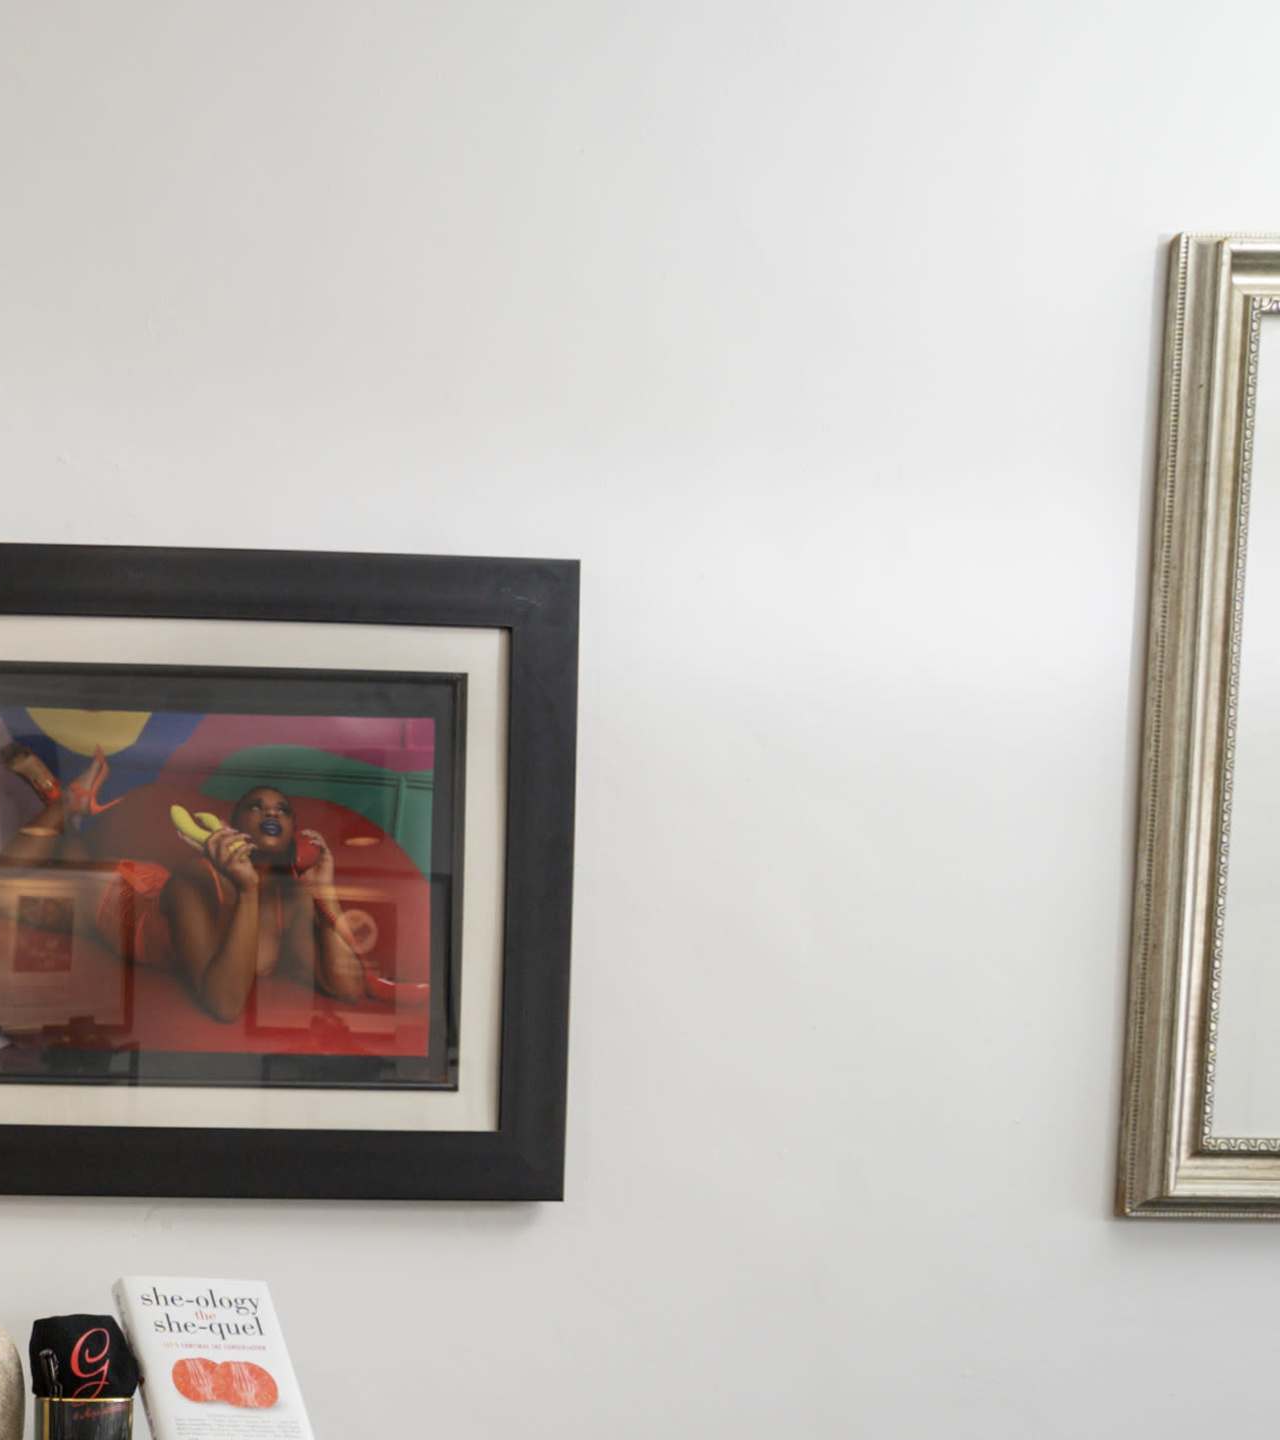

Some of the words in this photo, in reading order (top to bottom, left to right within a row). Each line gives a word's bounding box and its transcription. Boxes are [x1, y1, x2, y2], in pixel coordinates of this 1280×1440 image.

[141, 1287, 260, 1316] she-ology
[195, 1310, 216, 1321] the
[154, 1313, 265, 1341] she-quel
